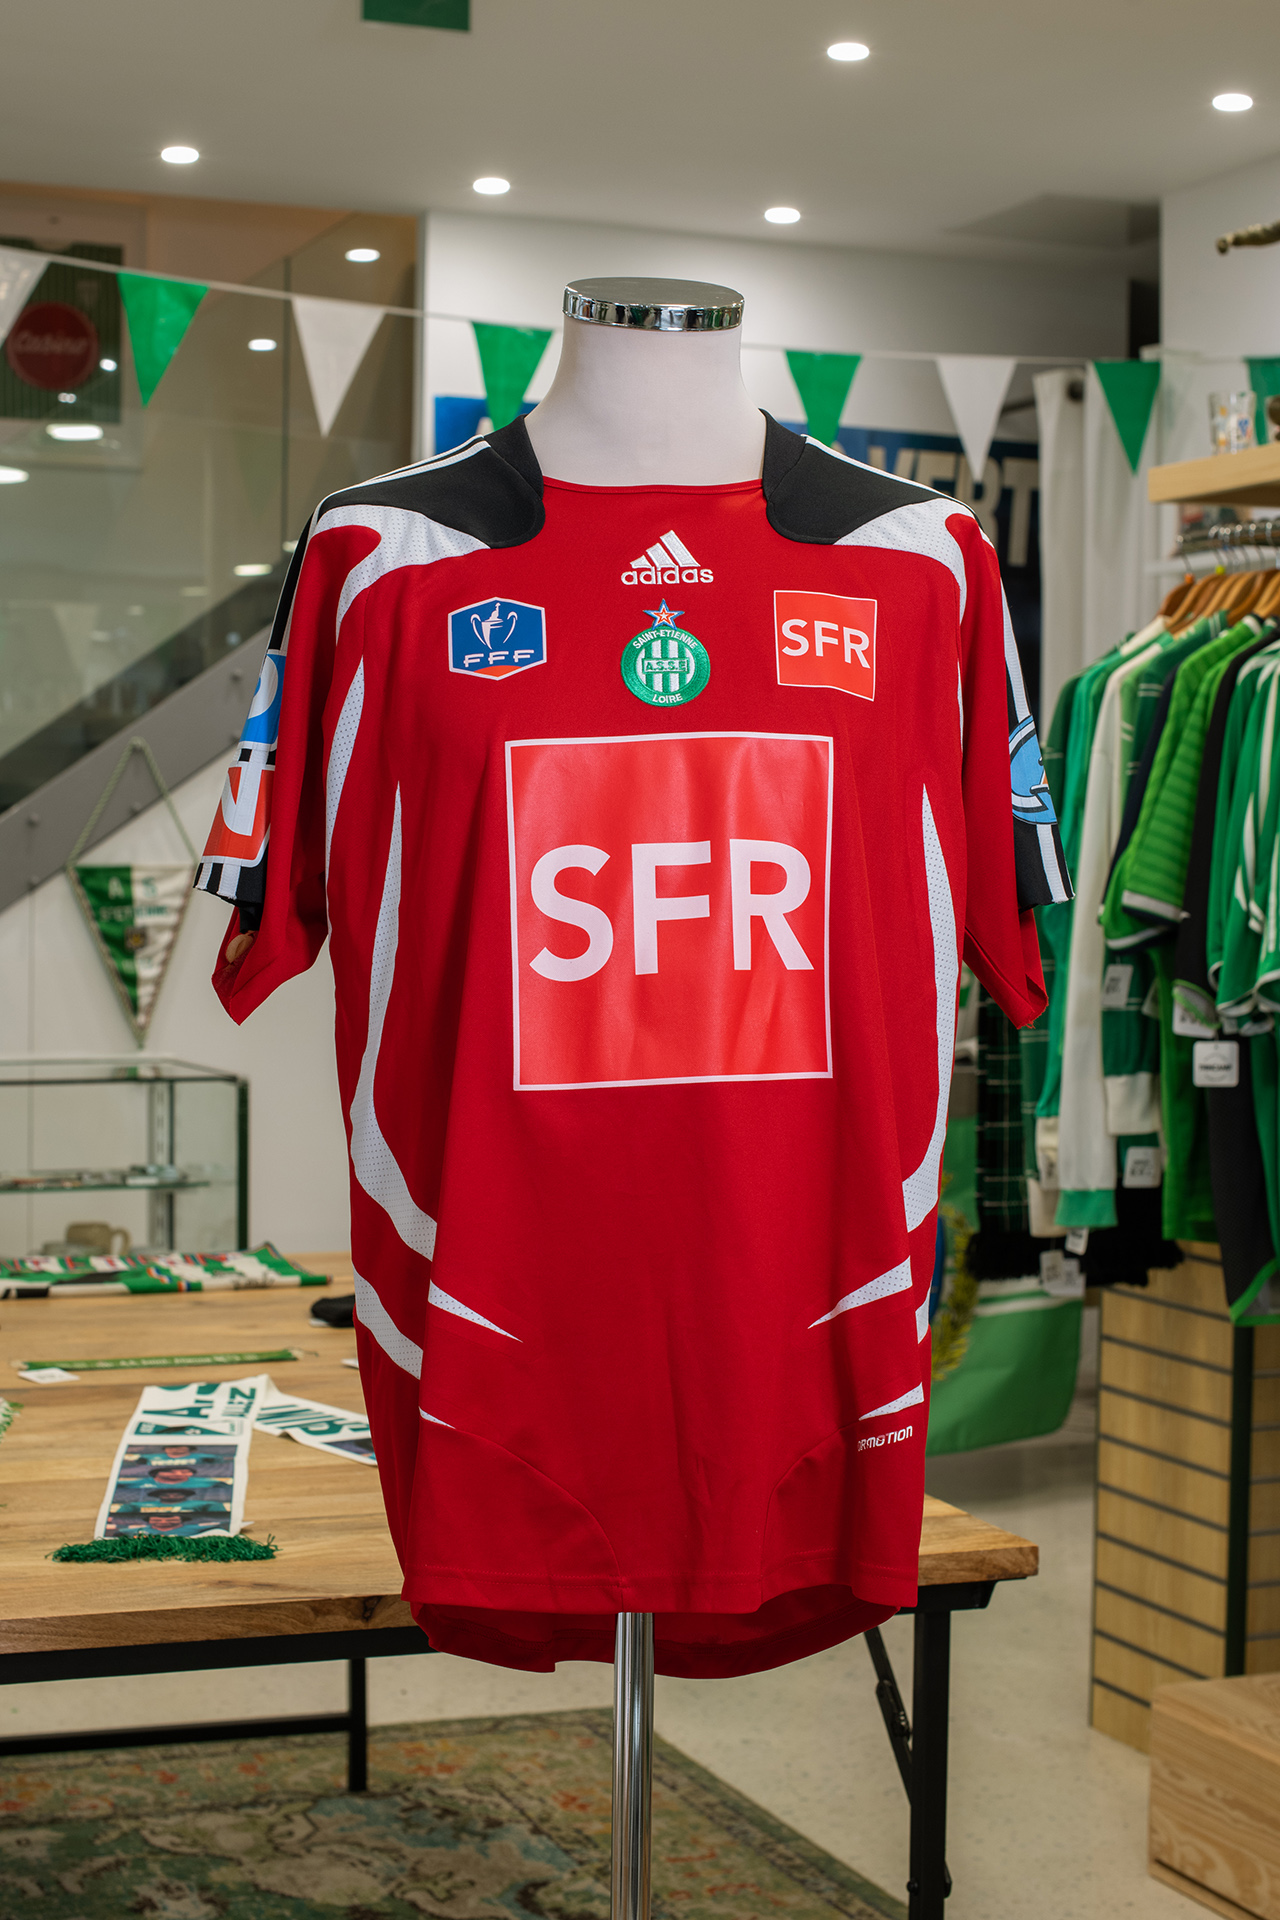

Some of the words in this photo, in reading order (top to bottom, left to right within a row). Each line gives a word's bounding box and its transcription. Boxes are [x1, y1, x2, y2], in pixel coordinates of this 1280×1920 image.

[621, 566, 714, 586] adidas
[632, 629, 698, 649] SAINT-ETIENNE
[781, 618, 871, 669] SFR
[463, 649, 535, 668] FFF
[652, 693, 684, 704] LOIRE
[529, 838, 815, 982] SFR
